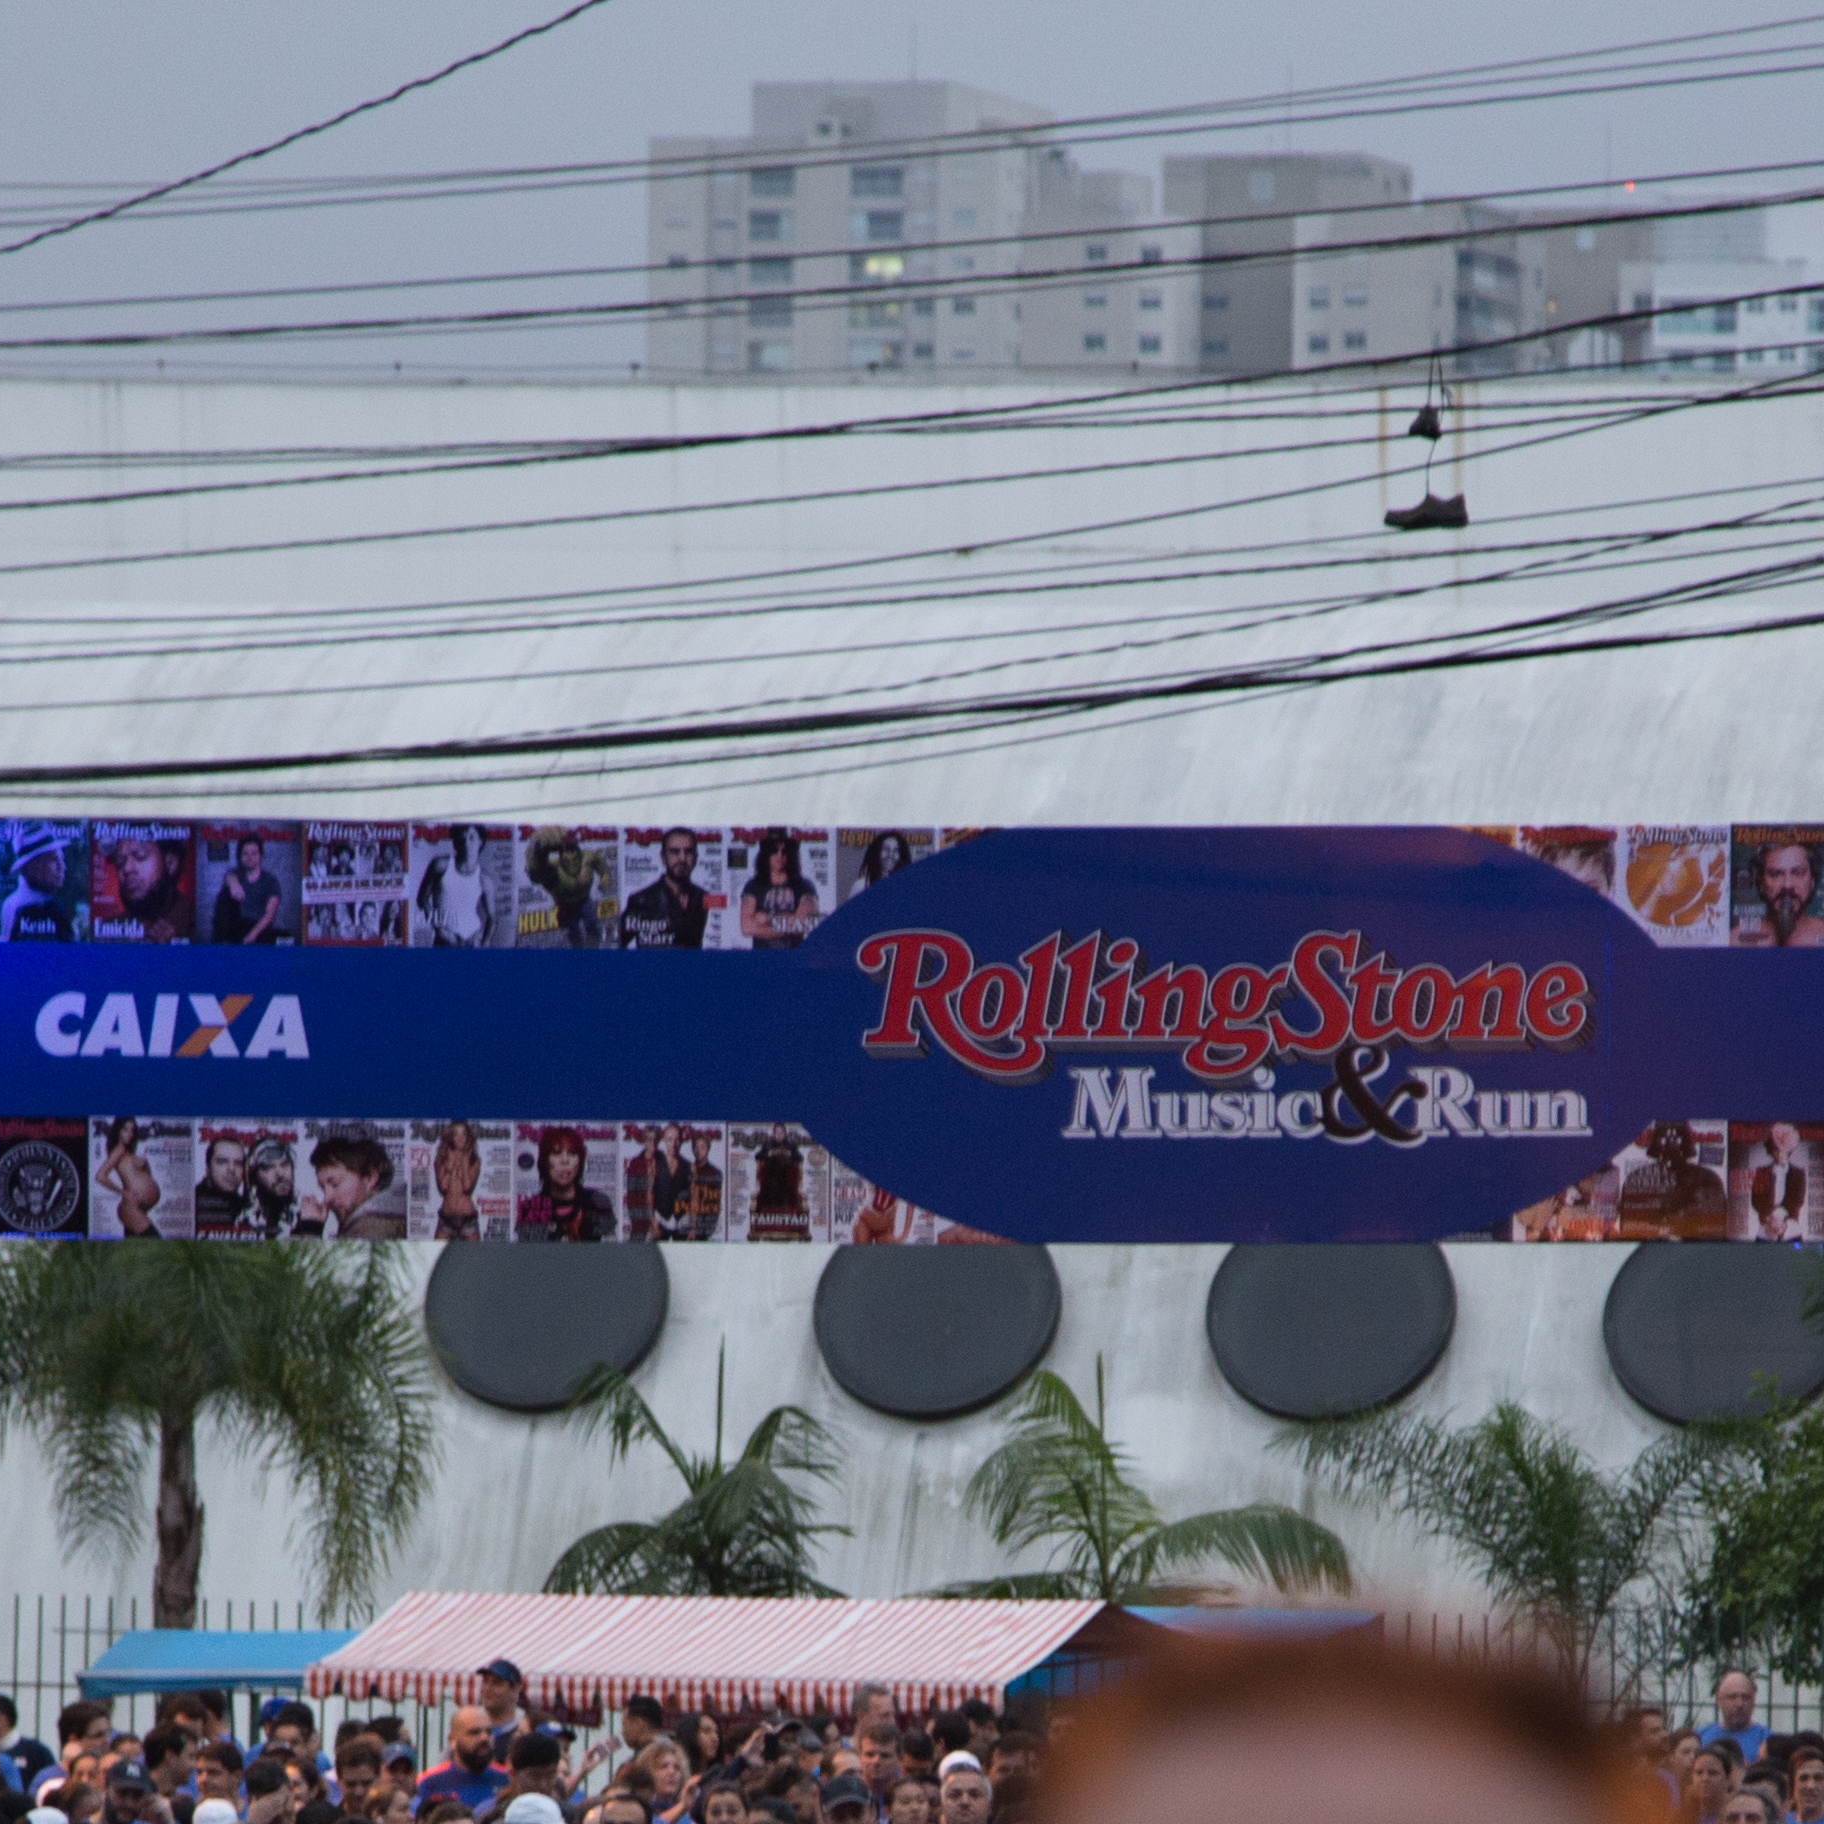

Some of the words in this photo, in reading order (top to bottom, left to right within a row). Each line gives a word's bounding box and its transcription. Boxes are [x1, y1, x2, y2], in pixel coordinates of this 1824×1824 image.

[94, 919, 145, 939] Emicida
[519, 909, 560, 934] HULK
[626, 916, 668, 933] Ringo
[638, 930, 675, 946] Starr
[857, 926, 1288, 1084] Rolling
[1269, 926, 1594, 1060] Stone
[34, 990, 310, 1060] CAIXA
[1060, 1064, 1328, 1140] Music
[1320, 1044, 1428, 1148] &
[1414, 1064, 1594, 1140] Run
